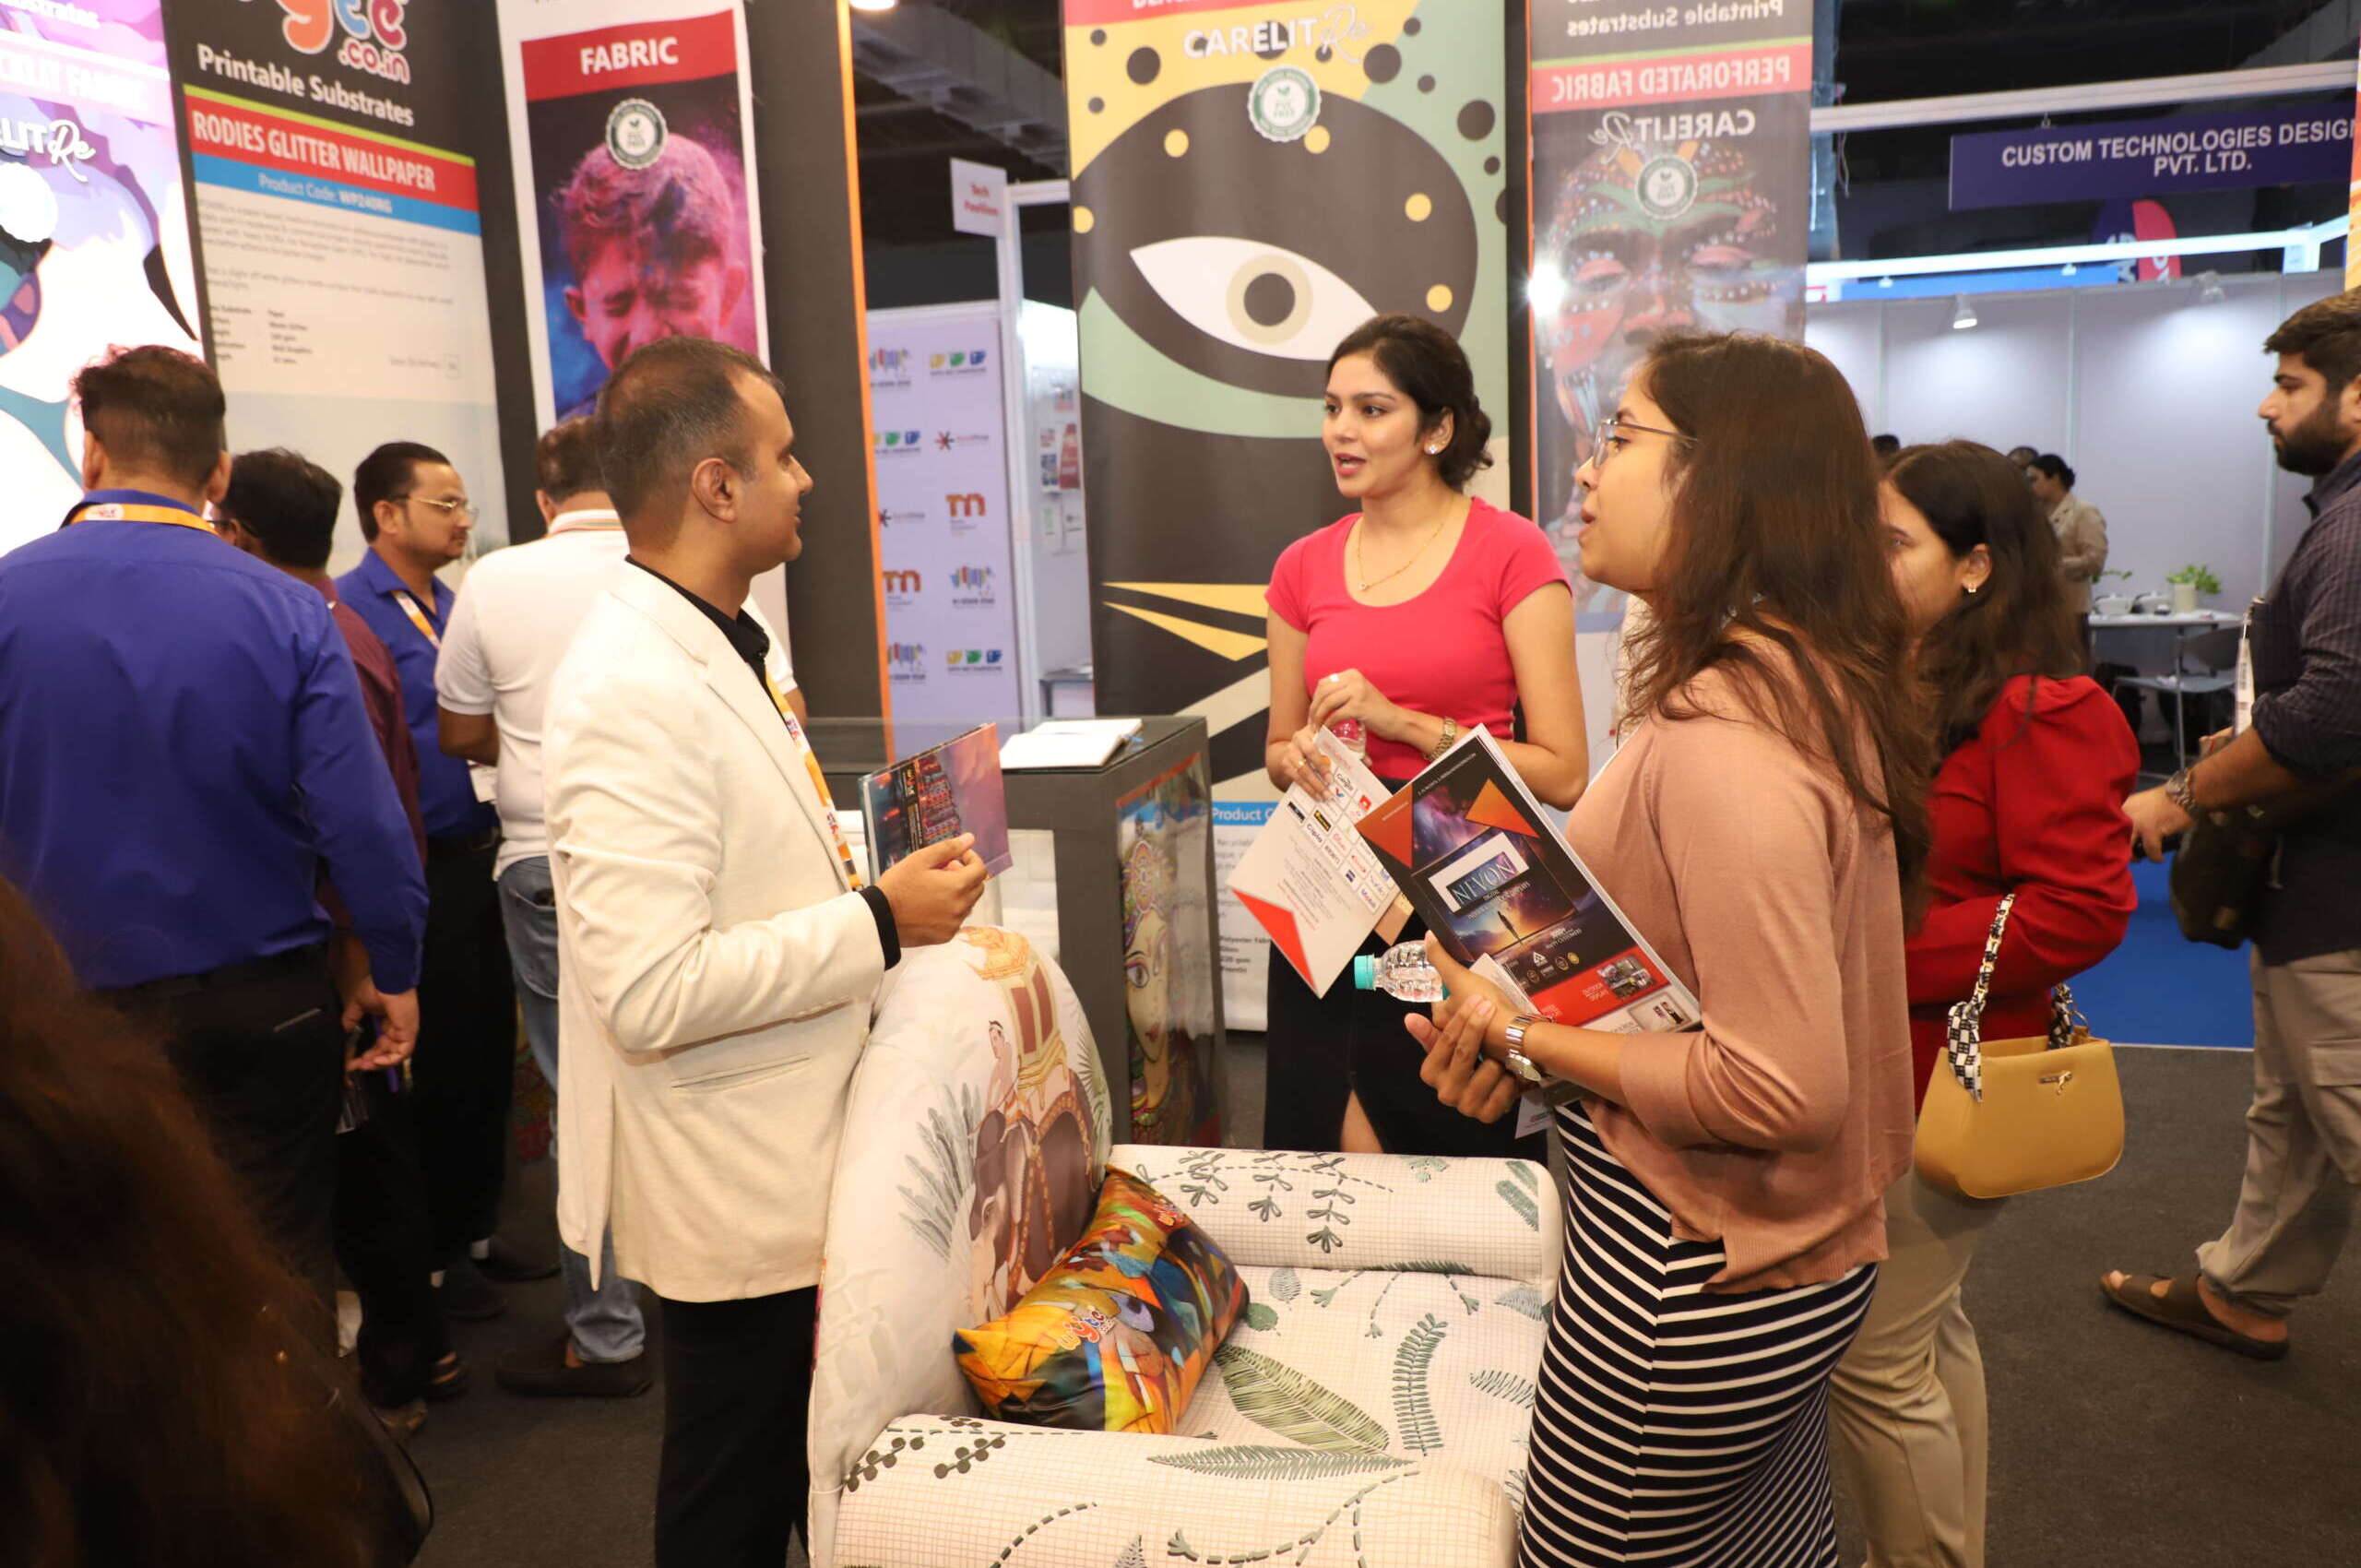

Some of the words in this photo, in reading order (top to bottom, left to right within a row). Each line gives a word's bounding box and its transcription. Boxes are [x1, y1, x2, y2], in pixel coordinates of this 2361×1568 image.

[580, 37, 679, 76] FABRIC
[1183, 18, 1318, 58] CARELIT
[197, 42, 305, 97] Printable
[308, 74, 415, 127] Substrates
[191, 110, 266, 153] RODIES
[267, 129, 341, 171] GLITTER
[340, 145, 436, 192] WALLPAPER
[2001, 140, 2093, 168] CUSTOM
[2098, 125, 2272, 160] TECHNOLOGIES
[2153, 153, 2200, 177] PVT.
[2204, 150, 2252, 174] LTD.
[1212, 808, 1262, 822] Product
